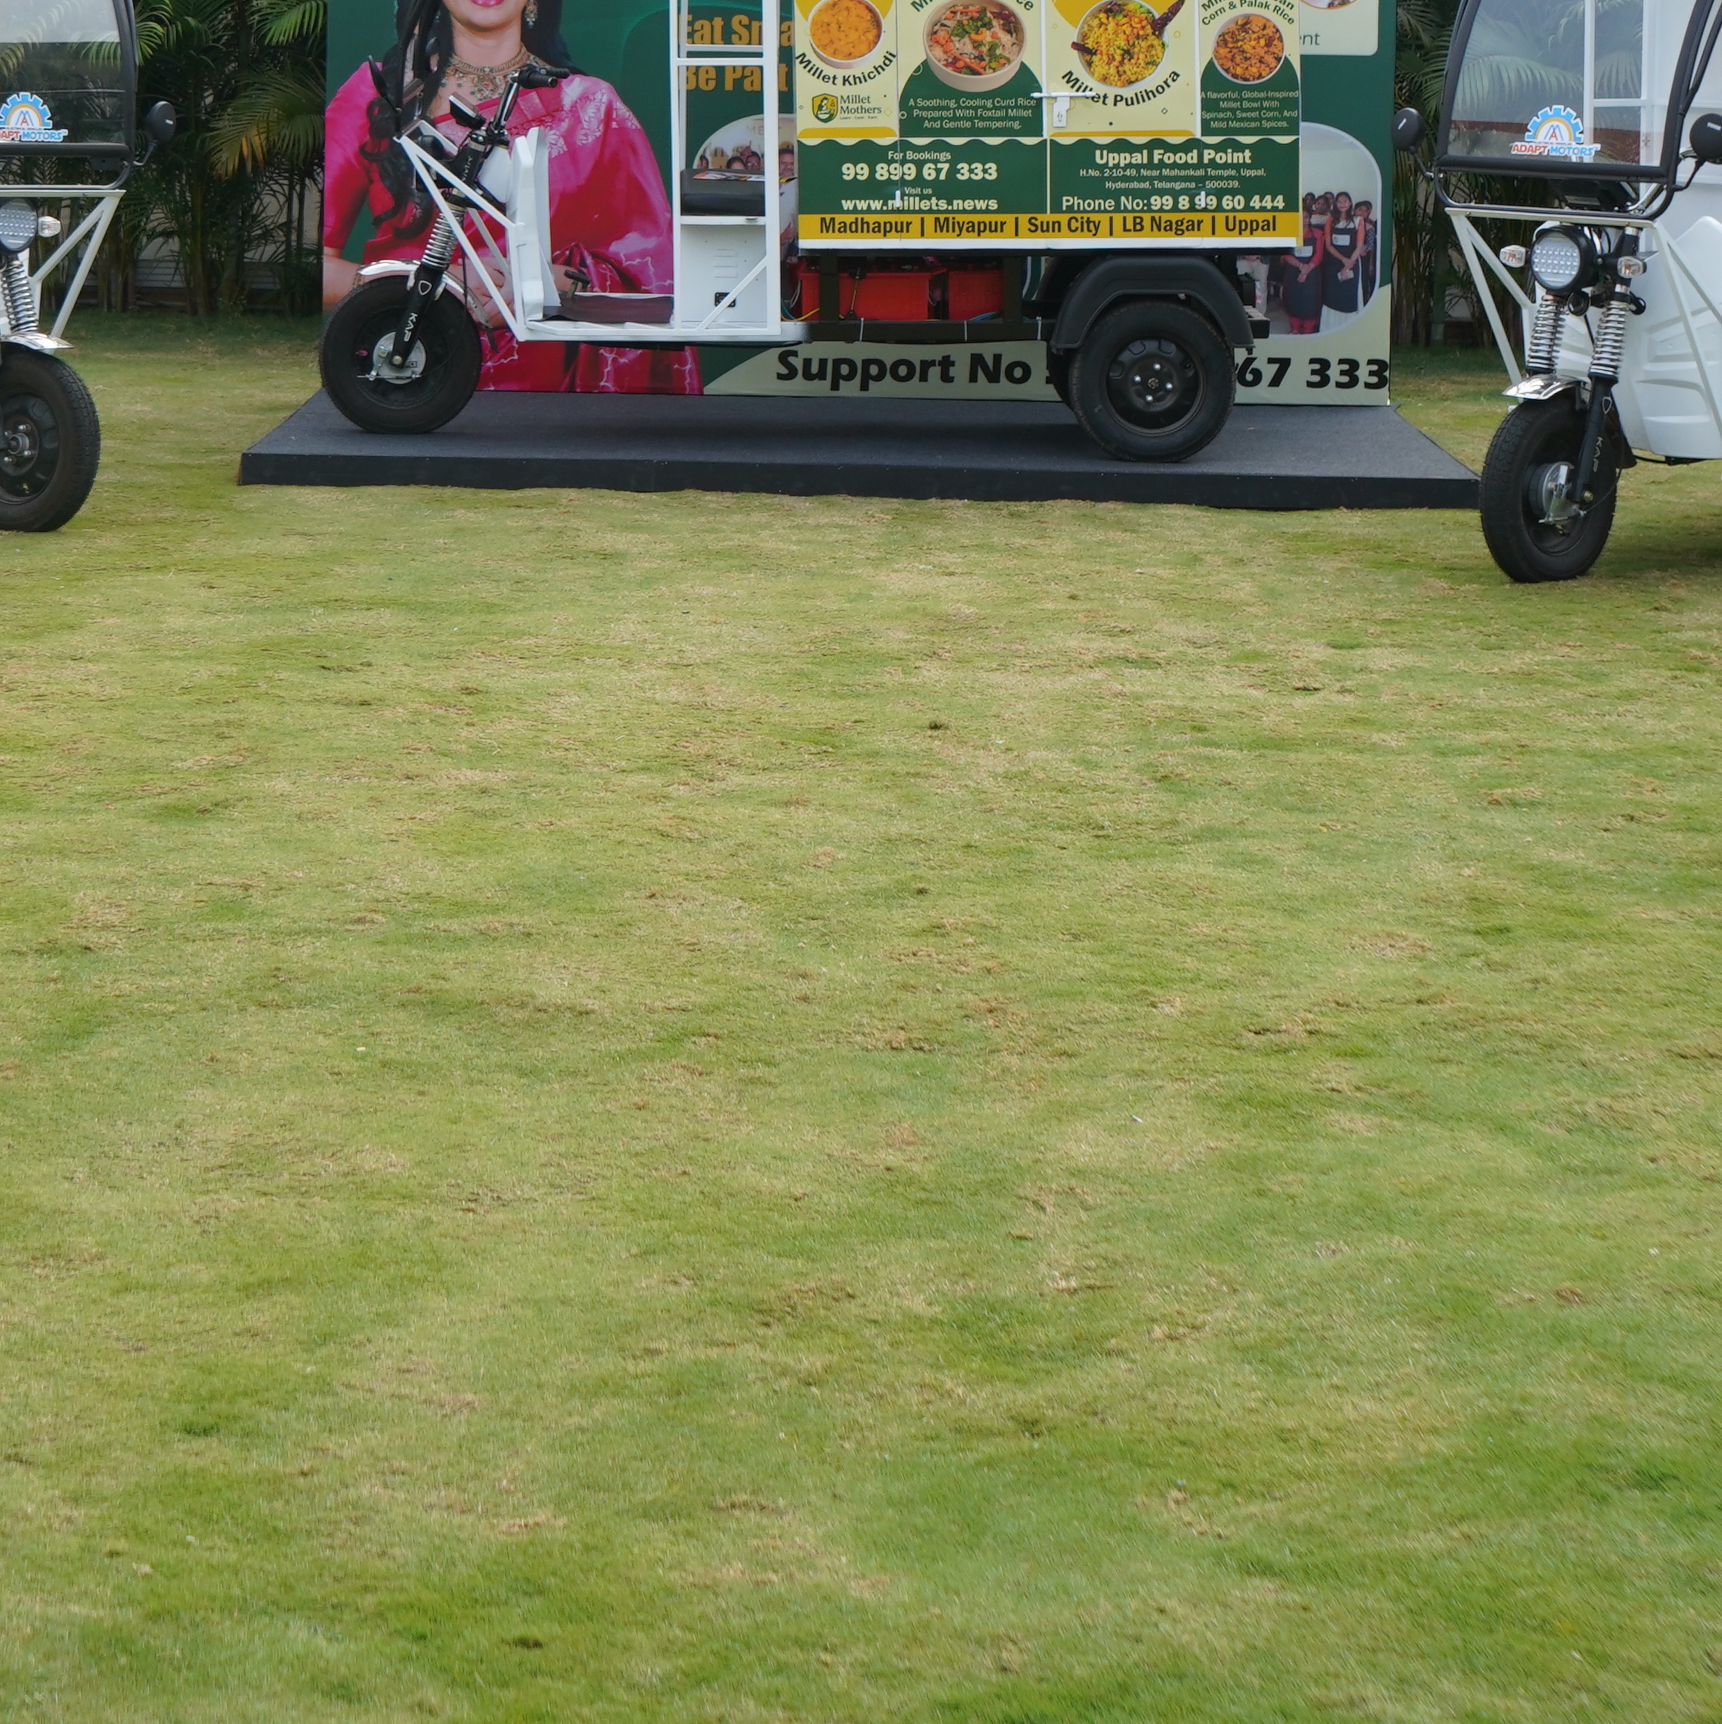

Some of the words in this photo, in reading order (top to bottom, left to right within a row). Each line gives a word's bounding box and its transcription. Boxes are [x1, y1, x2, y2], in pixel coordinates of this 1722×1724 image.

[1202, 5, 1226, 26] Corn
[1228, 1, 1237, 11] &
[1240, 0, 1270, 11] Palak
[1273, 7, 1295, 26] Rice
[795, 51, 838, 86] Millet
[842, 50, 897, 87] Khichdi
[1113, 70, 1181, 107] Pulihora
[839, 94, 871, 105] Millet
[839, 105, 882, 115] Mothers
[913, 109, 953, 119] Prepared
[955, 109, 975, 117] With
[977, 109, 1006, 117] Foxtail
[1008, 109, 1032, 117] Millet
[21, 131, 62, 141] MOTORS
[888, 151, 904, 160] For
[906, 151, 951, 162] Bookings
[1095, 149, 1147, 167] Uppal
[1153, 149, 1198, 164] Food
[1203, 149, 1252, 164] Point
[1513, 145, 1548, 154] ADAPT
[1550, 146, 1593, 156] MOTORS
[842, 163, 869, 180] 99
[875, 163, 916, 180] 899
[922, 163, 950, 180] 67
[956, 162, 998, 180] 333
[1062, 196, 1117, 211] Phone
[1120, 196, 1148, 210] No:
[1150, 196, 1173, 210] 99
[1178, 195, 1190, 210] 8
[1222, 195, 1245, 210] 60
[1250, 195, 1285, 210] 444
[819, 216, 912, 237] Madhapur
[934, 216, 1007, 237] Miyapur
[1027, 216, 1061, 233] Sun
[1067, 216, 1101, 236] City
[1122, 216, 1145, 232] LB
[1150, 216, 1204, 236] Nagar
[1224, 215, 1277, 235] Uppal
[777, 350, 955, 391] Support
[968, 353, 1032, 382] No
[1237, 357, 1291, 388] 67
[1306, 358, 1389, 390] 333
